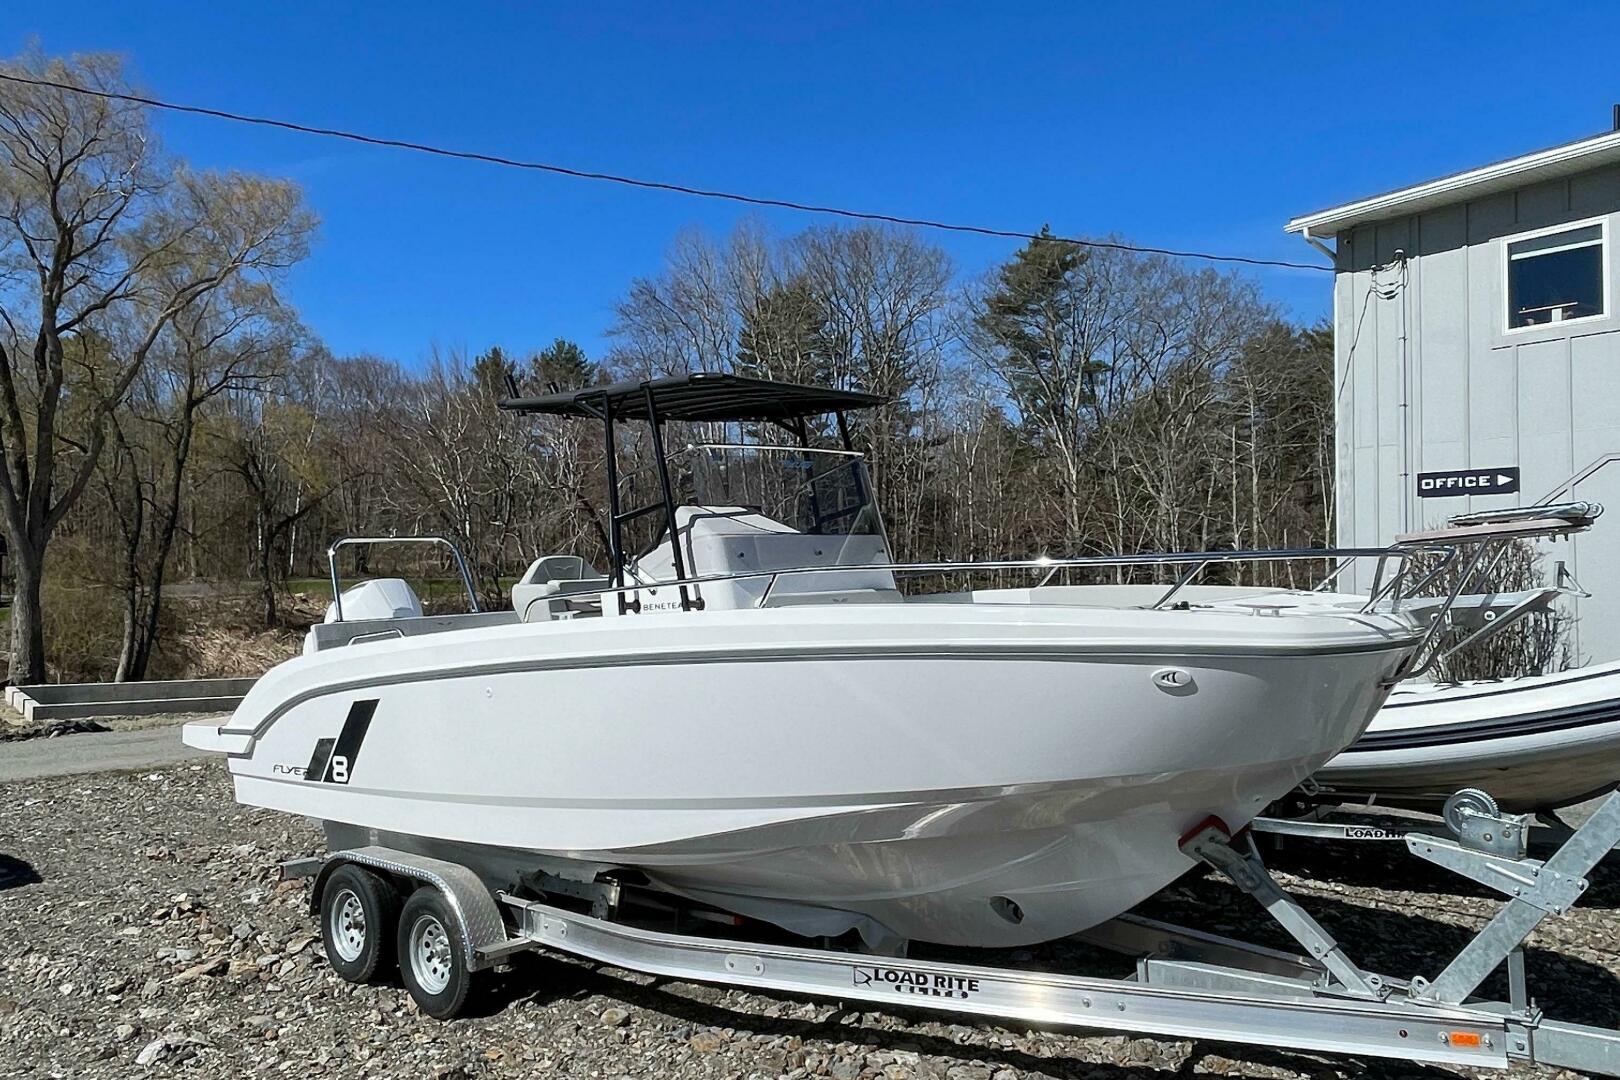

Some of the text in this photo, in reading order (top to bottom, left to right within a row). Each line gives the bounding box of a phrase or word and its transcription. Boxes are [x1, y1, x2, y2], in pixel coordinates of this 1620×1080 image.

[1421, 475, 1491, 490] OFFICE
[643, 602, 683, 611] BENETEA
[332, 755, 349, 783] 8
[874, 968, 980, 992] LOAD RITE
